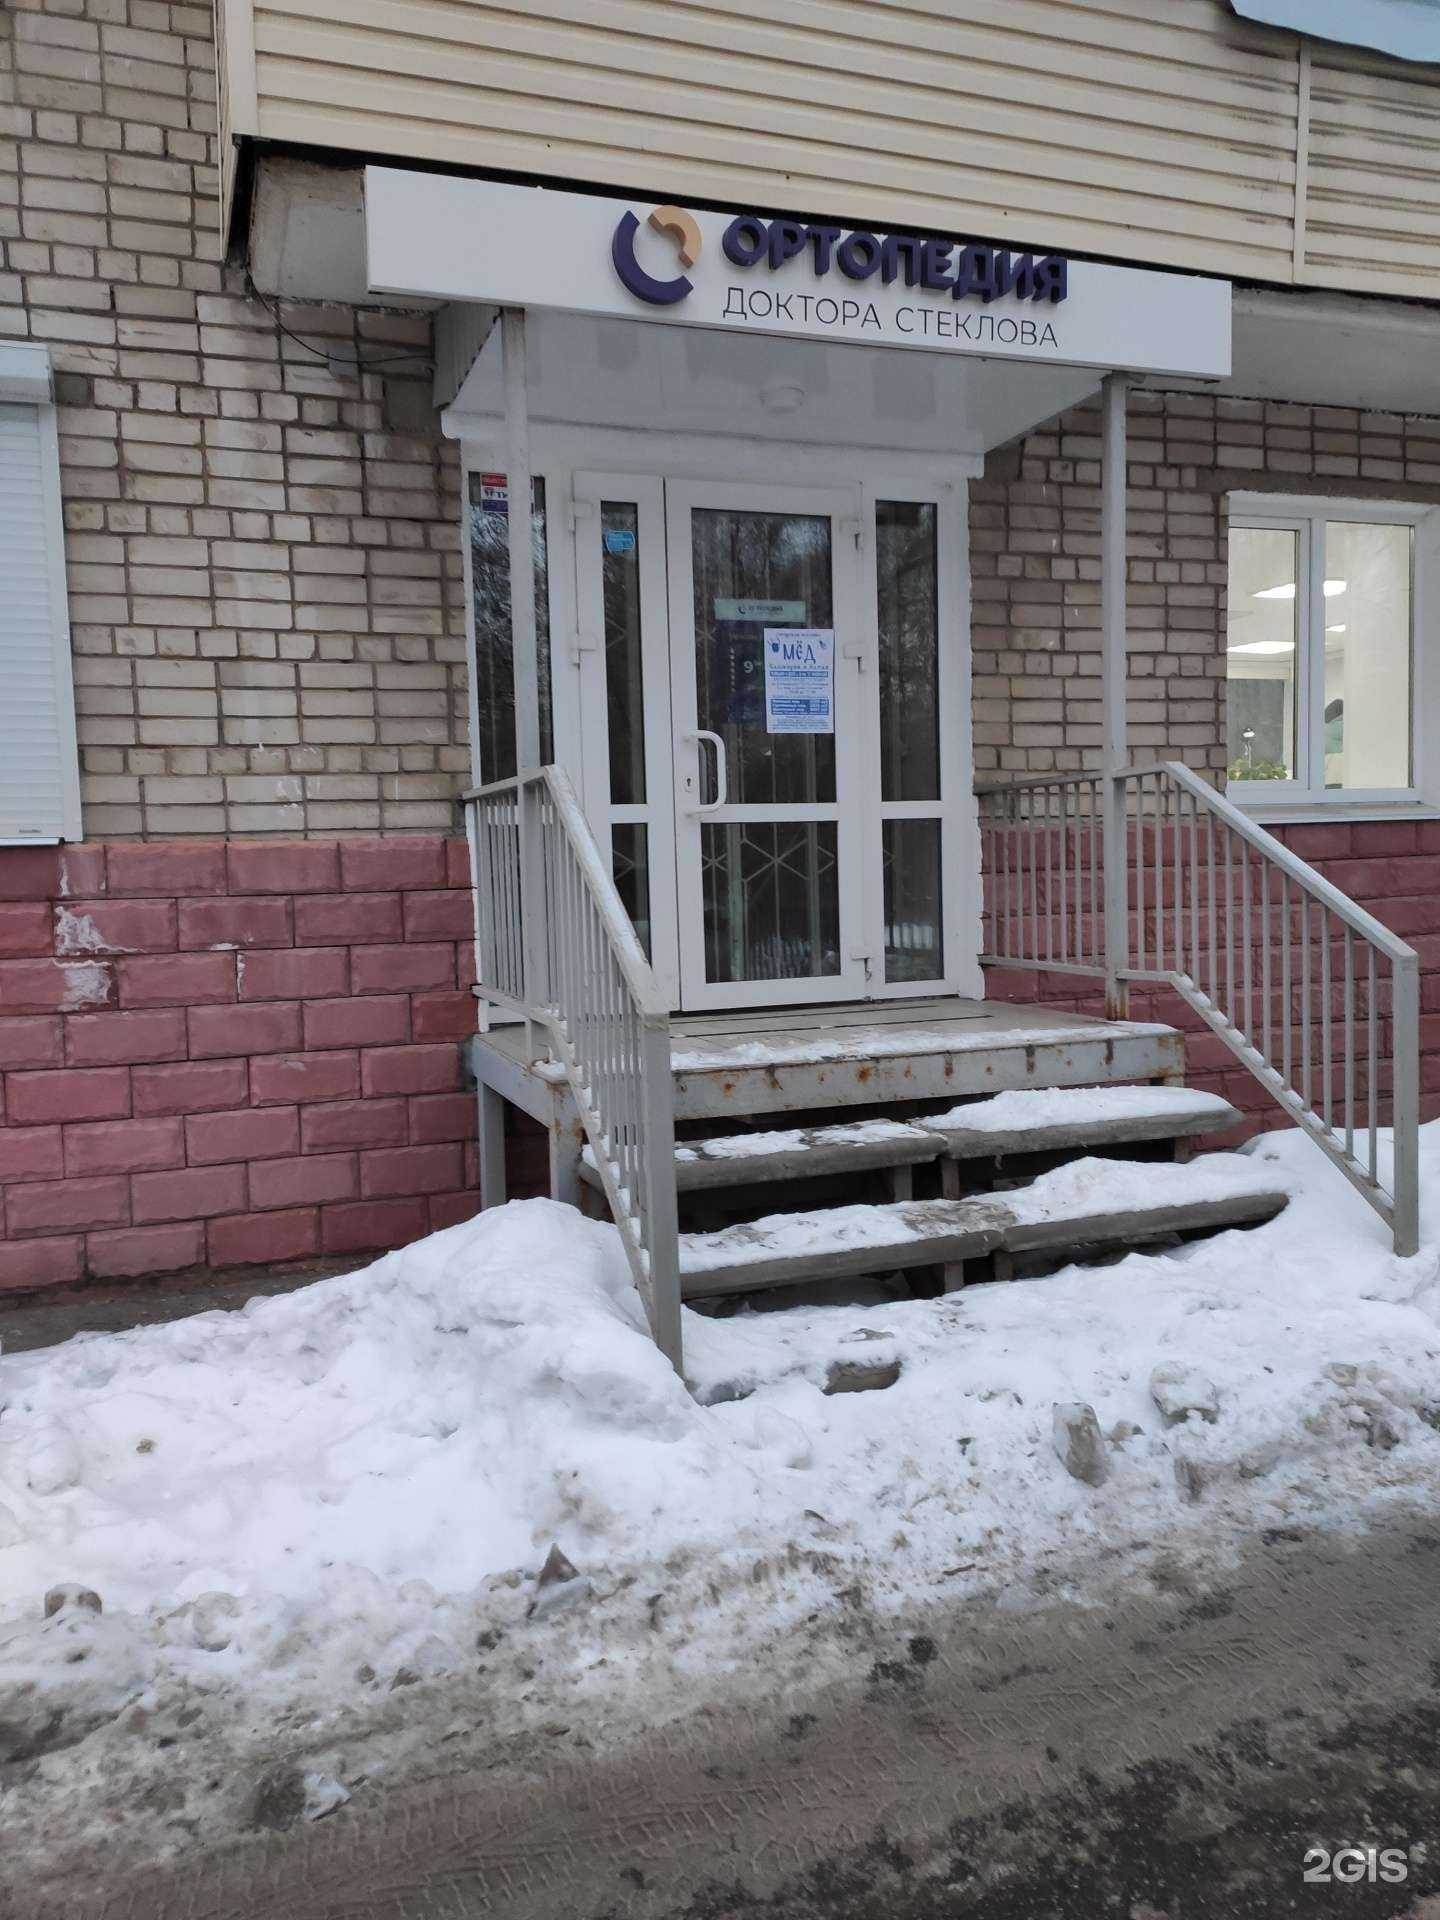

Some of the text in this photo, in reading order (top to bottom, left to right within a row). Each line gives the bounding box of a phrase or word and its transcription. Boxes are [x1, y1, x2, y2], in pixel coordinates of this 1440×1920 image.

[722, 214, 1068, 304] ОРТОПЕДИЯ
[722, 286, 1059, 348] ДОКТОРА СТЕКЛОВА
